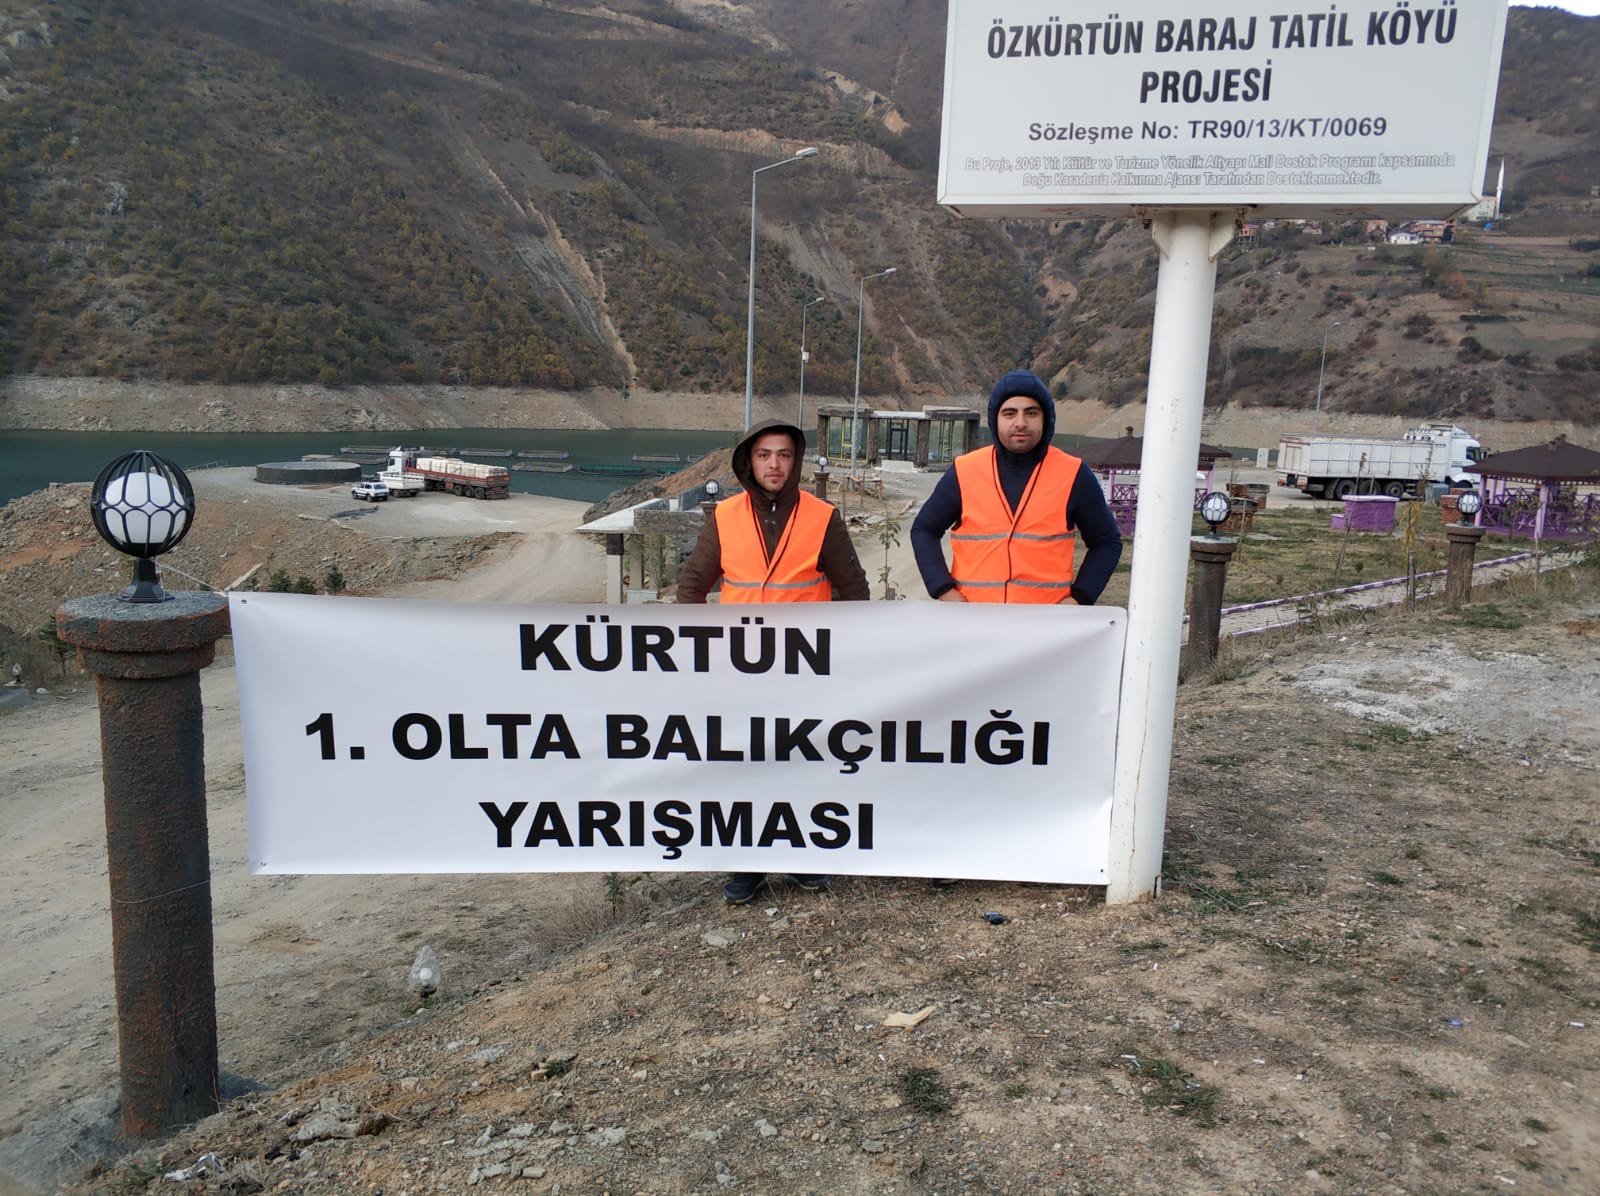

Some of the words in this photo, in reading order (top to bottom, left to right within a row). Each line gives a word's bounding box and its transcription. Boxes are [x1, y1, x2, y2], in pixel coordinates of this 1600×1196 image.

[988, 13, 1142, 58] ÖZKÜRTÜN
[1156, 17, 1255, 52] BARAJ
[1270, 4, 1353, 48] TATİL
[1367, 0, 1457, 46] KÖYÜ
[1140, 59, 1272, 103] PROJESİ
[1028, 121, 1133, 143] Sözleşme
[1141, 121, 1179, 140] No:
[1188, 117, 1387, 139] TR90/13/KT/0069
[965, 157, 980, 170] Bu
[982, 157, 1013, 173] Proje,
[1015, 157, 1040, 170] 2013
[1042, 156, 1060, 169] Yılı
[1062, 155, 1096, 169] Kültür
[1098, 159, 1113, 169] ve
[1114, 156, 1159, 169] Turizme
[1160, 155, 1204, 168] Yönelik
[1204, 155, 1246, 171] Altyapı
[1248, 154, 1273, 168] Mali
[1275, 154, 1318, 168] Destek
[1319, 154, 1376, 170] Programı
[1378, 153, 1455, 169] kapsamında
[1023, 172, 1052, 189] Doğu
[1054, 172, 1108, 186] Karadeniz
[1111, 172, 1162, 185] Kalkınma
[1163, 172, 1201, 188] Ajansı
[1203, 172, 1264, 185] Tarafından
[1266, 171, 1382, 185] Desteklenmektedir.
[518, 614, 831, 675] KÜRTÜN
[305, 712, 365, 760] 1.
[391, 712, 581, 760] OLTA
[606, 708, 1050, 774] BALIKÇILIĞI
[479, 800, 874, 860] YARIŞMASI
